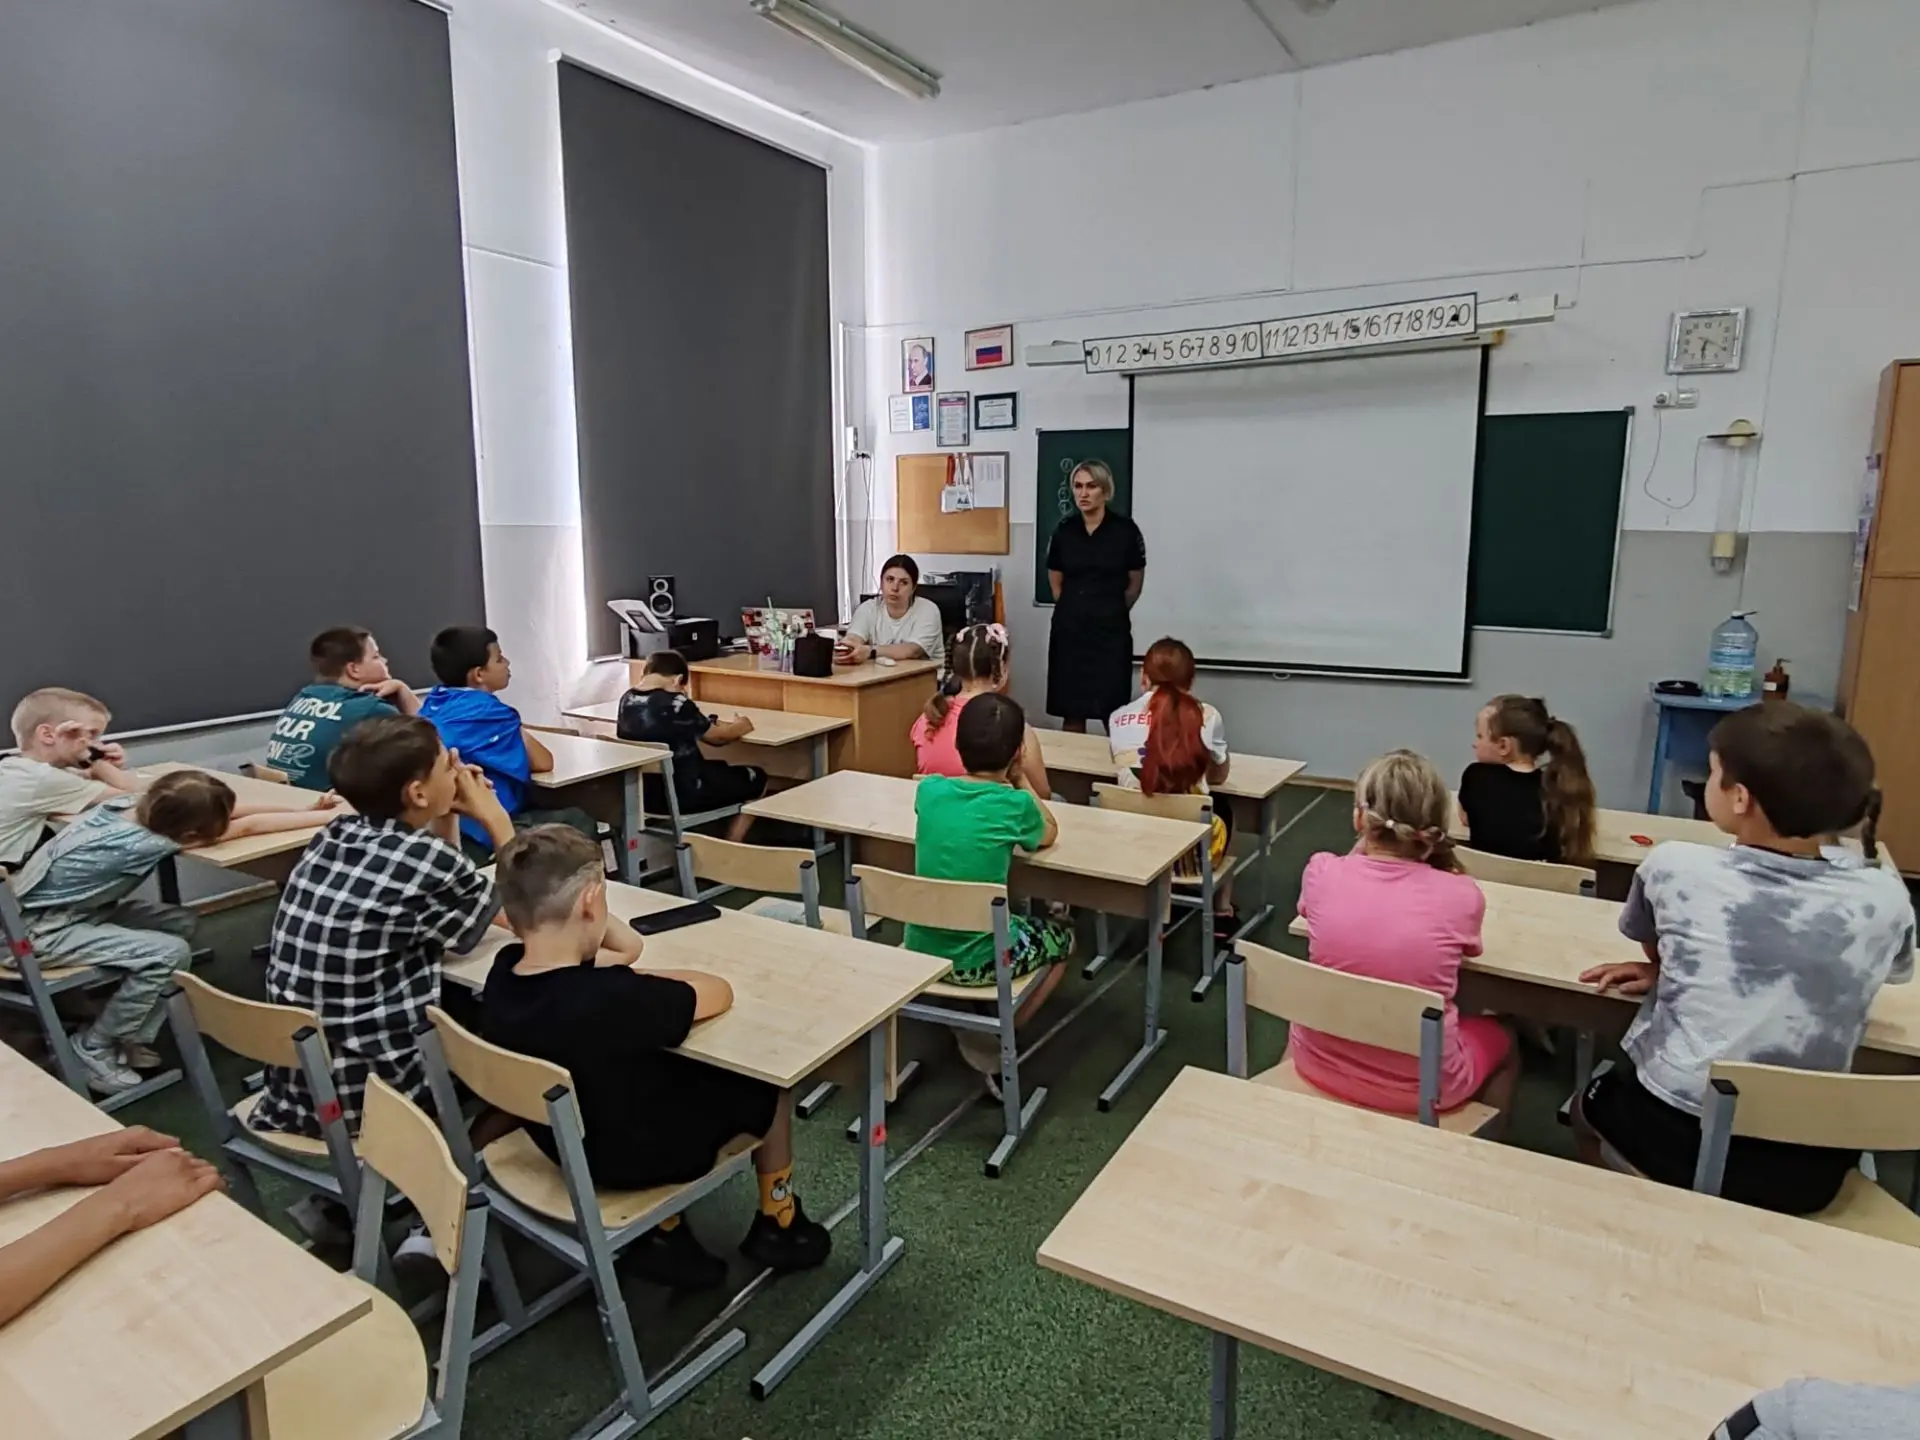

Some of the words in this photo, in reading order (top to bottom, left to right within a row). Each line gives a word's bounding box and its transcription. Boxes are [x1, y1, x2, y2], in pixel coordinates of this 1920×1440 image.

[1264, 328, 1279, 350] 11
[1282, 325, 1299, 348] 12
[1302, 322, 1319, 345] 13
[1323, 320, 1339, 343] 14
[1343, 317, 1360, 340] 15
[1364, 314, 1381, 337] 16
[1384, 312, 1403, 336] 17
[1406, 309, 1423, 333] 18
[1426, 306, 1444, 330] 19
[1445, 303, 1471, 327] 20
[1091, 346, 1101, 366] 0
[1105, 344, 1112, 364] 1
[1116, 344, 1127, 364] 2
[1132, 342, 1143, 363] 3
[1145, 341, 1157, 361] 4
[1163, 340, 1174, 360] 5
[1179, 338, 1192, 359] 6
[1195, 337, 1205, 357] 7
[1209, 335, 1220, 356] 8
[1225, 333, 1237, 354] 9
[1240, 331, 1258, 352] 10
